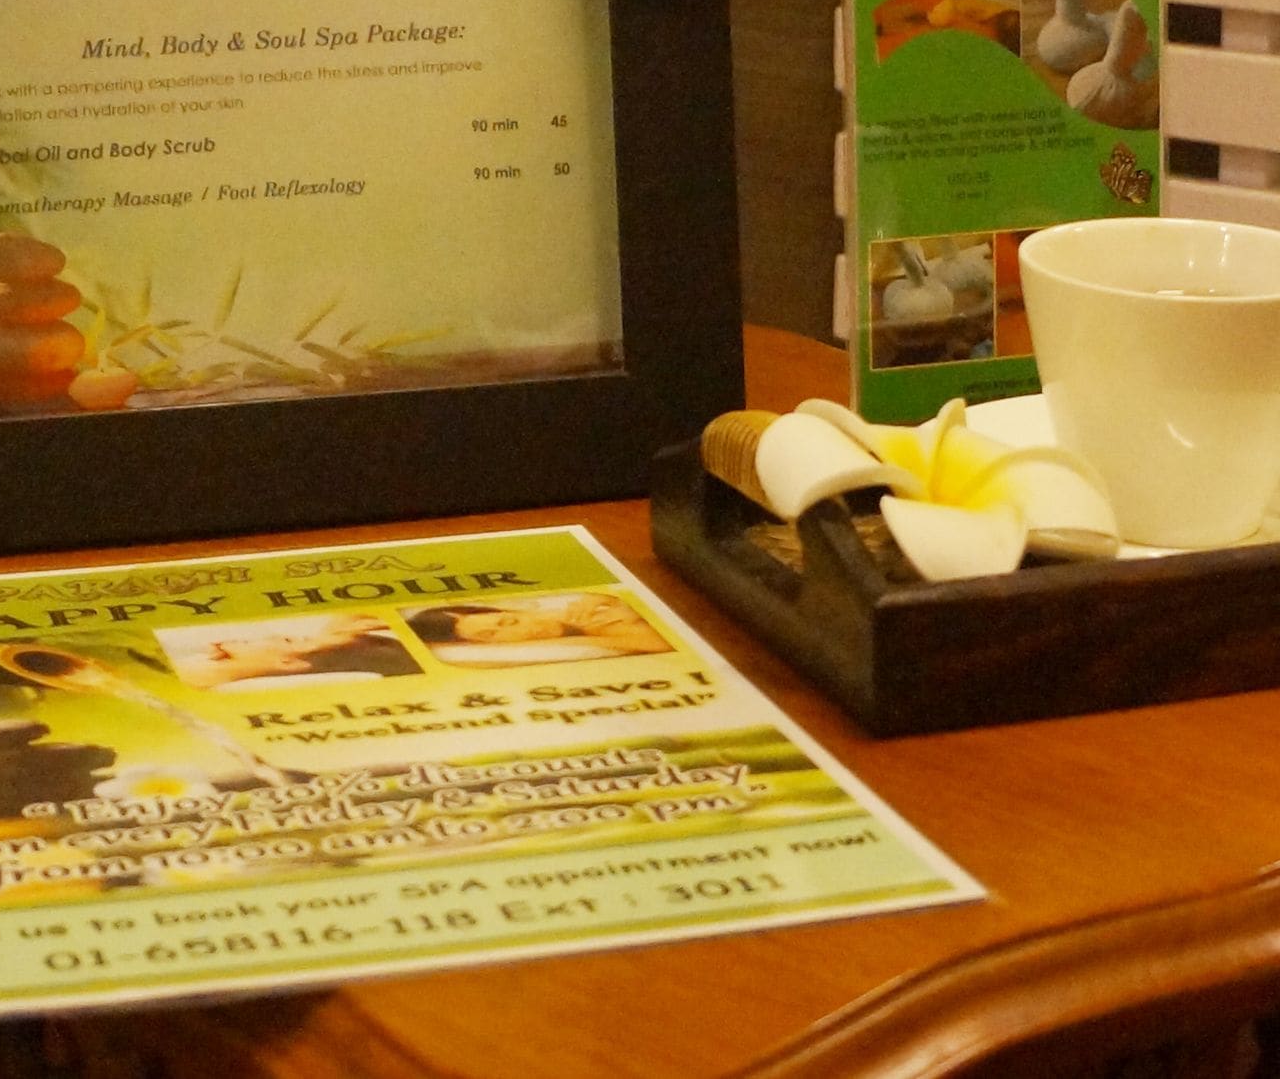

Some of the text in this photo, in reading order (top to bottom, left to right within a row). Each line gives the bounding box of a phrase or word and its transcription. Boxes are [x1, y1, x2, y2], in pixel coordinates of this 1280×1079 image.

[82, 23, 466, 59] Mind, Body & Soul Spa Package:
[7, 83, 37, 97] with
[43, 85, 52, 96] a
[57, 78, 143, 97] pampering
[148, 74, 234, 91] experience
[258, 69, 312, 83] reduce
[318, 67, 340, 80] the
[347, 65, 384, 79] stress
[388, 62, 417, 76] and
[421, 60, 483, 77] improve
[47, 106, 78, 120] and
[82, 102, 156, 119] hydration
[180, 99, 213, 114] your
[472, 114, 568, 132] 90 min 45
[35, 145, 61, 162] Oil
[66, 143, 103, 161] and
[110, 141, 157, 159] Body
[162, 137, 216, 155] Scrub
[474, 162, 571, 181] 90 min 50
[113, 189, 192, 209] Massage
[201, 186, 209, 202] /
[217, 184, 256, 202] Foot
[264, 178, 365, 200] Reflexology
[263, 570, 541, 609] HOUR
[246, 697, 432, 729] Relax
[459, 692, 510, 710] &
[528, 677, 673, 703] Save
[59, 820, 216, 849] every
[222, 796, 420, 834] Friday
[433, 786, 476, 810] &
[493, 764, 748, 804] Saturday
[66, 791, 234, 824] Enjoy
[141, 837, 314, 871] 10:00
[321, 822, 426, 854] am
[428, 817, 491, 841] to
[508, 803, 630, 833] 2:00
[643, 793, 737, 825] pm
[19, 923, 70, 941] us
[88, 916, 137, 933] to
[153, 901, 265, 925] book
[279, 889, 378, 917] your
[400, 877, 488, 901] SPA
[506, 844, 772, 890] appointment
[789, 829, 881, 856] now!
[43, 907, 478, 973] 01-658116-118
[499, 896, 600, 925] Ext
[662, 871, 783, 903] 3011
